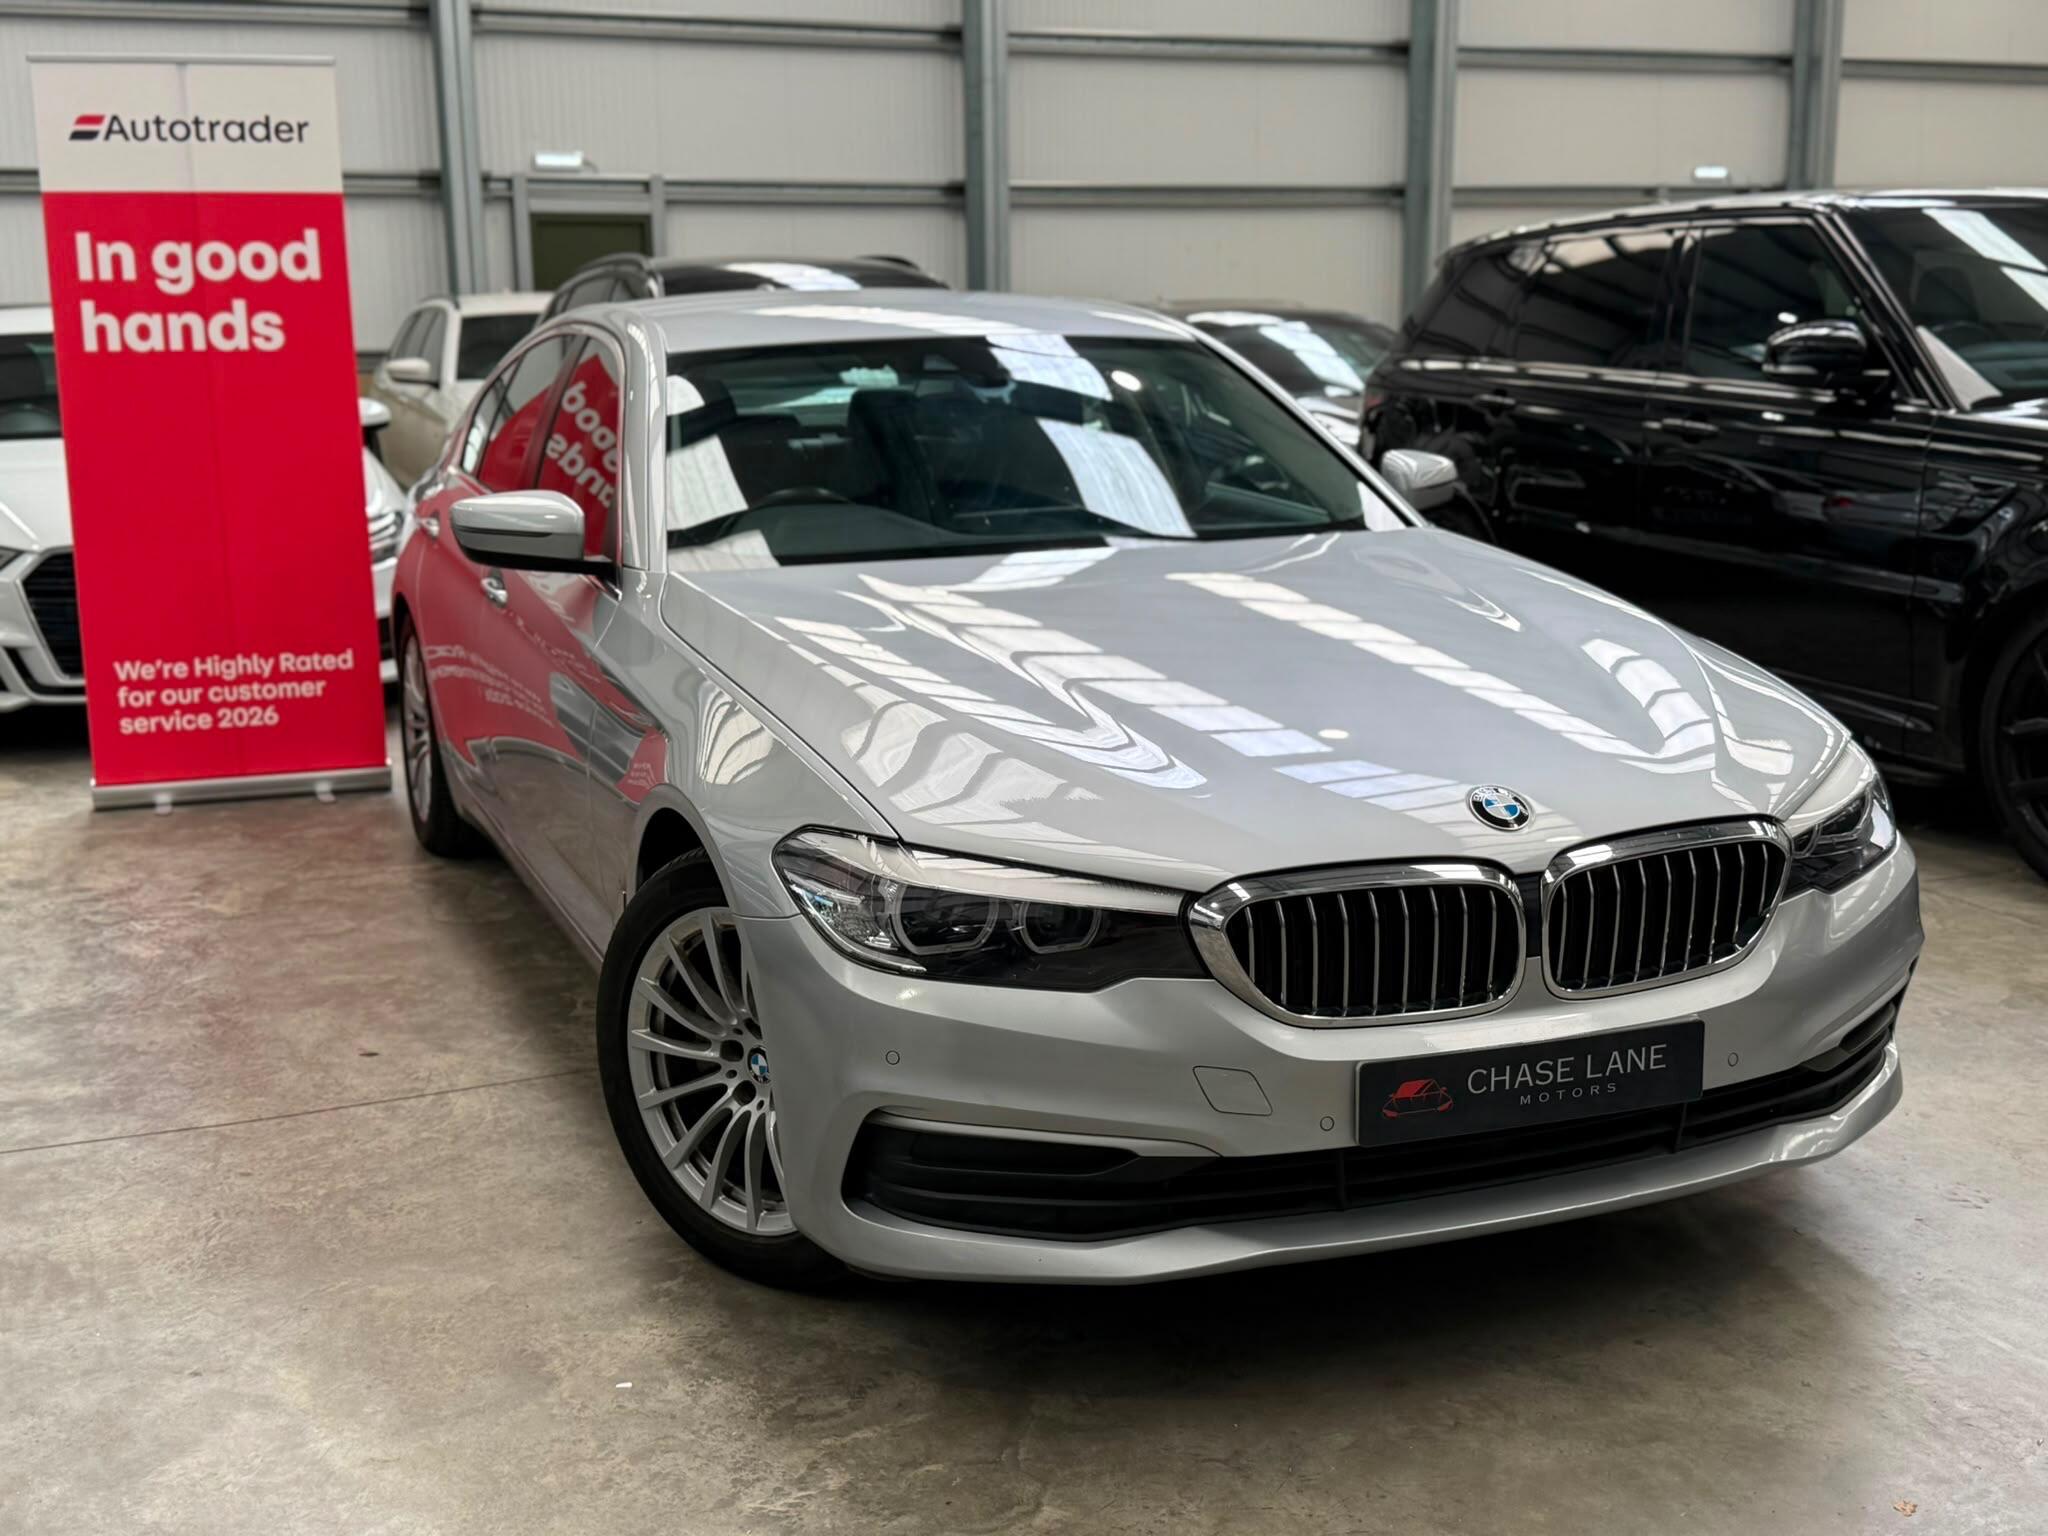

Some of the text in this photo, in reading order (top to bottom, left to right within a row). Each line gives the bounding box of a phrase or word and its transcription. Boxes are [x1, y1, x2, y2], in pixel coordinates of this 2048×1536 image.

[104, 115, 309, 142] Autotrader
[75, 228, 321, 295] In good
[80, 299, 286, 353] hands
[194, 654, 274, 680] Highly
[279, 648, 354, 673] Rated
[117, 680, 326, 708] for our customer
[119, 706, 280, 735] service 2026
[1467, 1044, 1668, 1094] CHASE LANE
[1519, 1082, 1617, 1105] MOTORS
